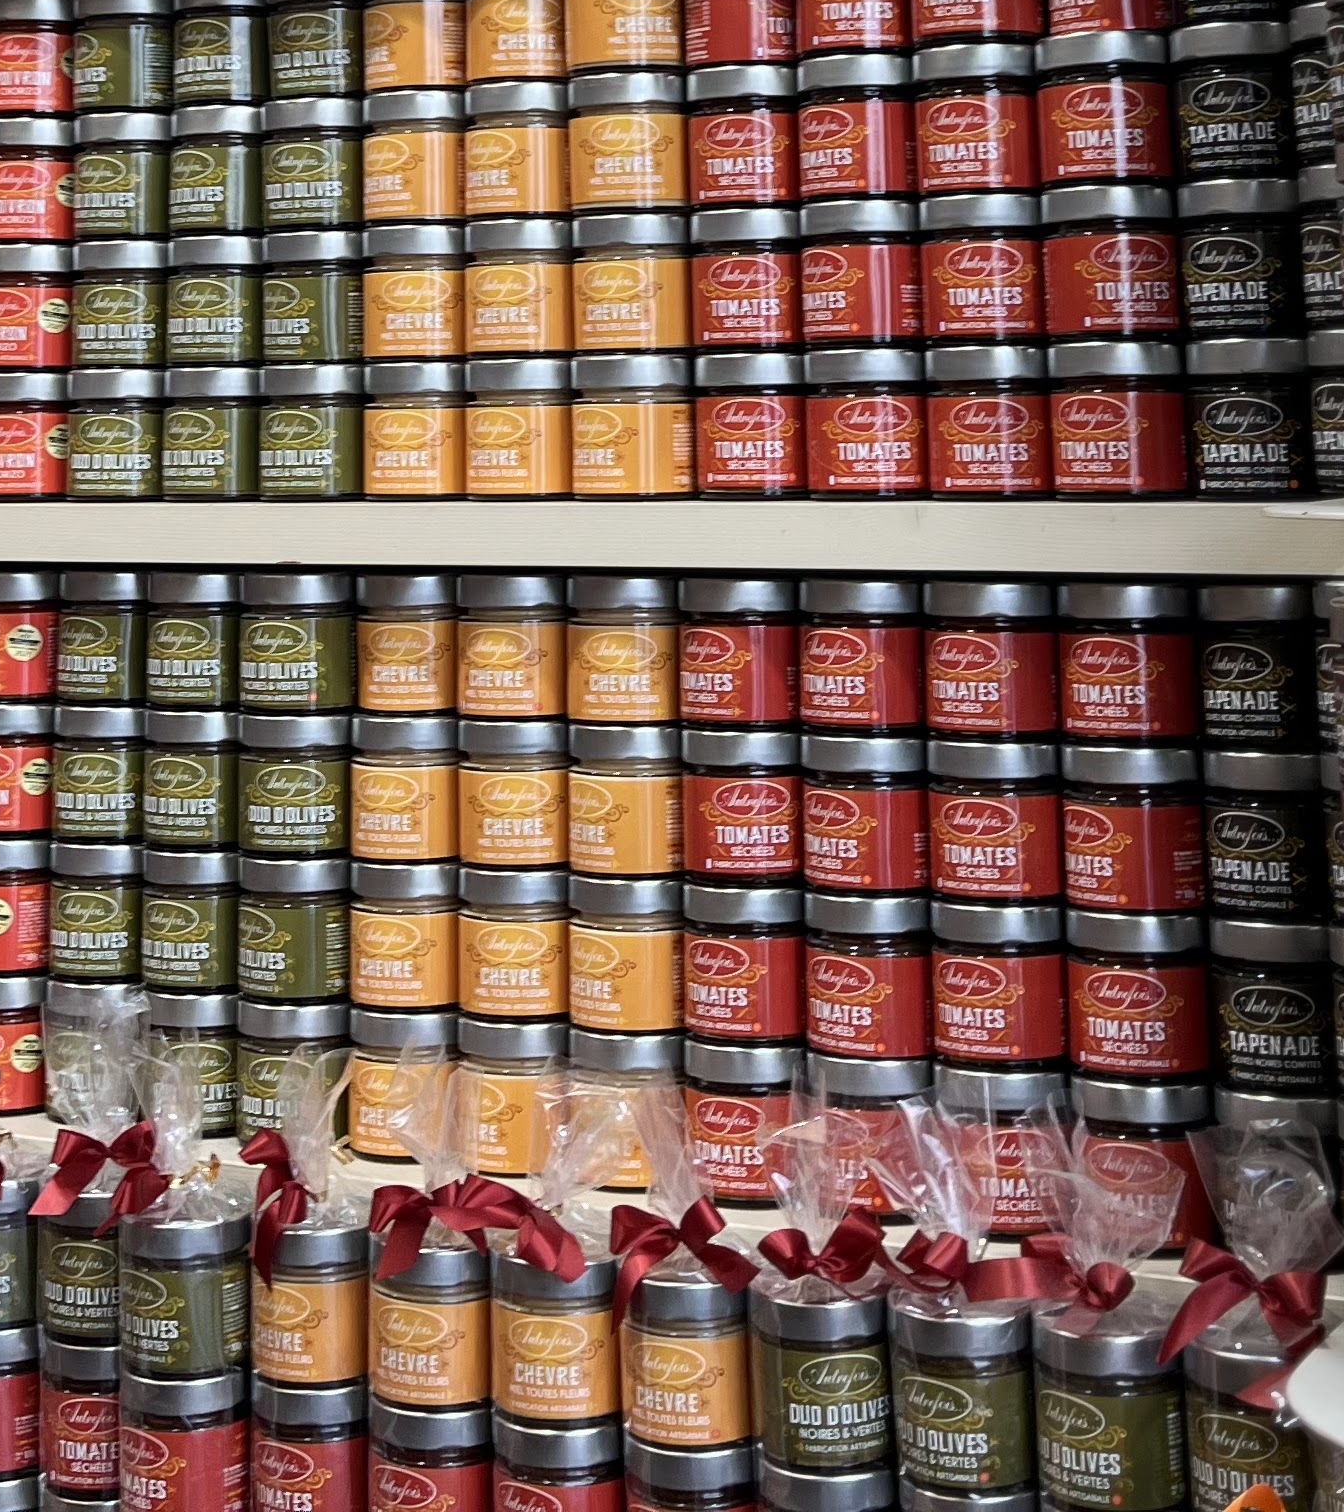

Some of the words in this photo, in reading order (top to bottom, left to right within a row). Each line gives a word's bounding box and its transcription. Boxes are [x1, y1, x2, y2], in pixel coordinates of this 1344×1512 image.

[821, 1, 894, 21] TOMATES
[1065, 127, 1143, 149] TOMATES
[947, 287, 1022, 307] TOMATES
[714, 441, 784, 459] TOMATES
[837, 443, 911, 460] TOMATES
[1202, 442, 1288, 463] TAPENADE
[1072, 684, 1145, 705] TOMATES
[715, 825, 790, 846] TOMATES
[1086, 1019, 1166, 1042] TOMATES
[1229, 1031, 1319, 1057] TAPENADE
[527, 1387, 557, 1399] TOUTES
[559, 1388, 590, 1399] FLEURS
[789, 1403, 822, 1425] DUO
[918, 1428, 988, 1455] D'OLIVES
[1051, 1447, 1120, 1475] D'OLIVES
